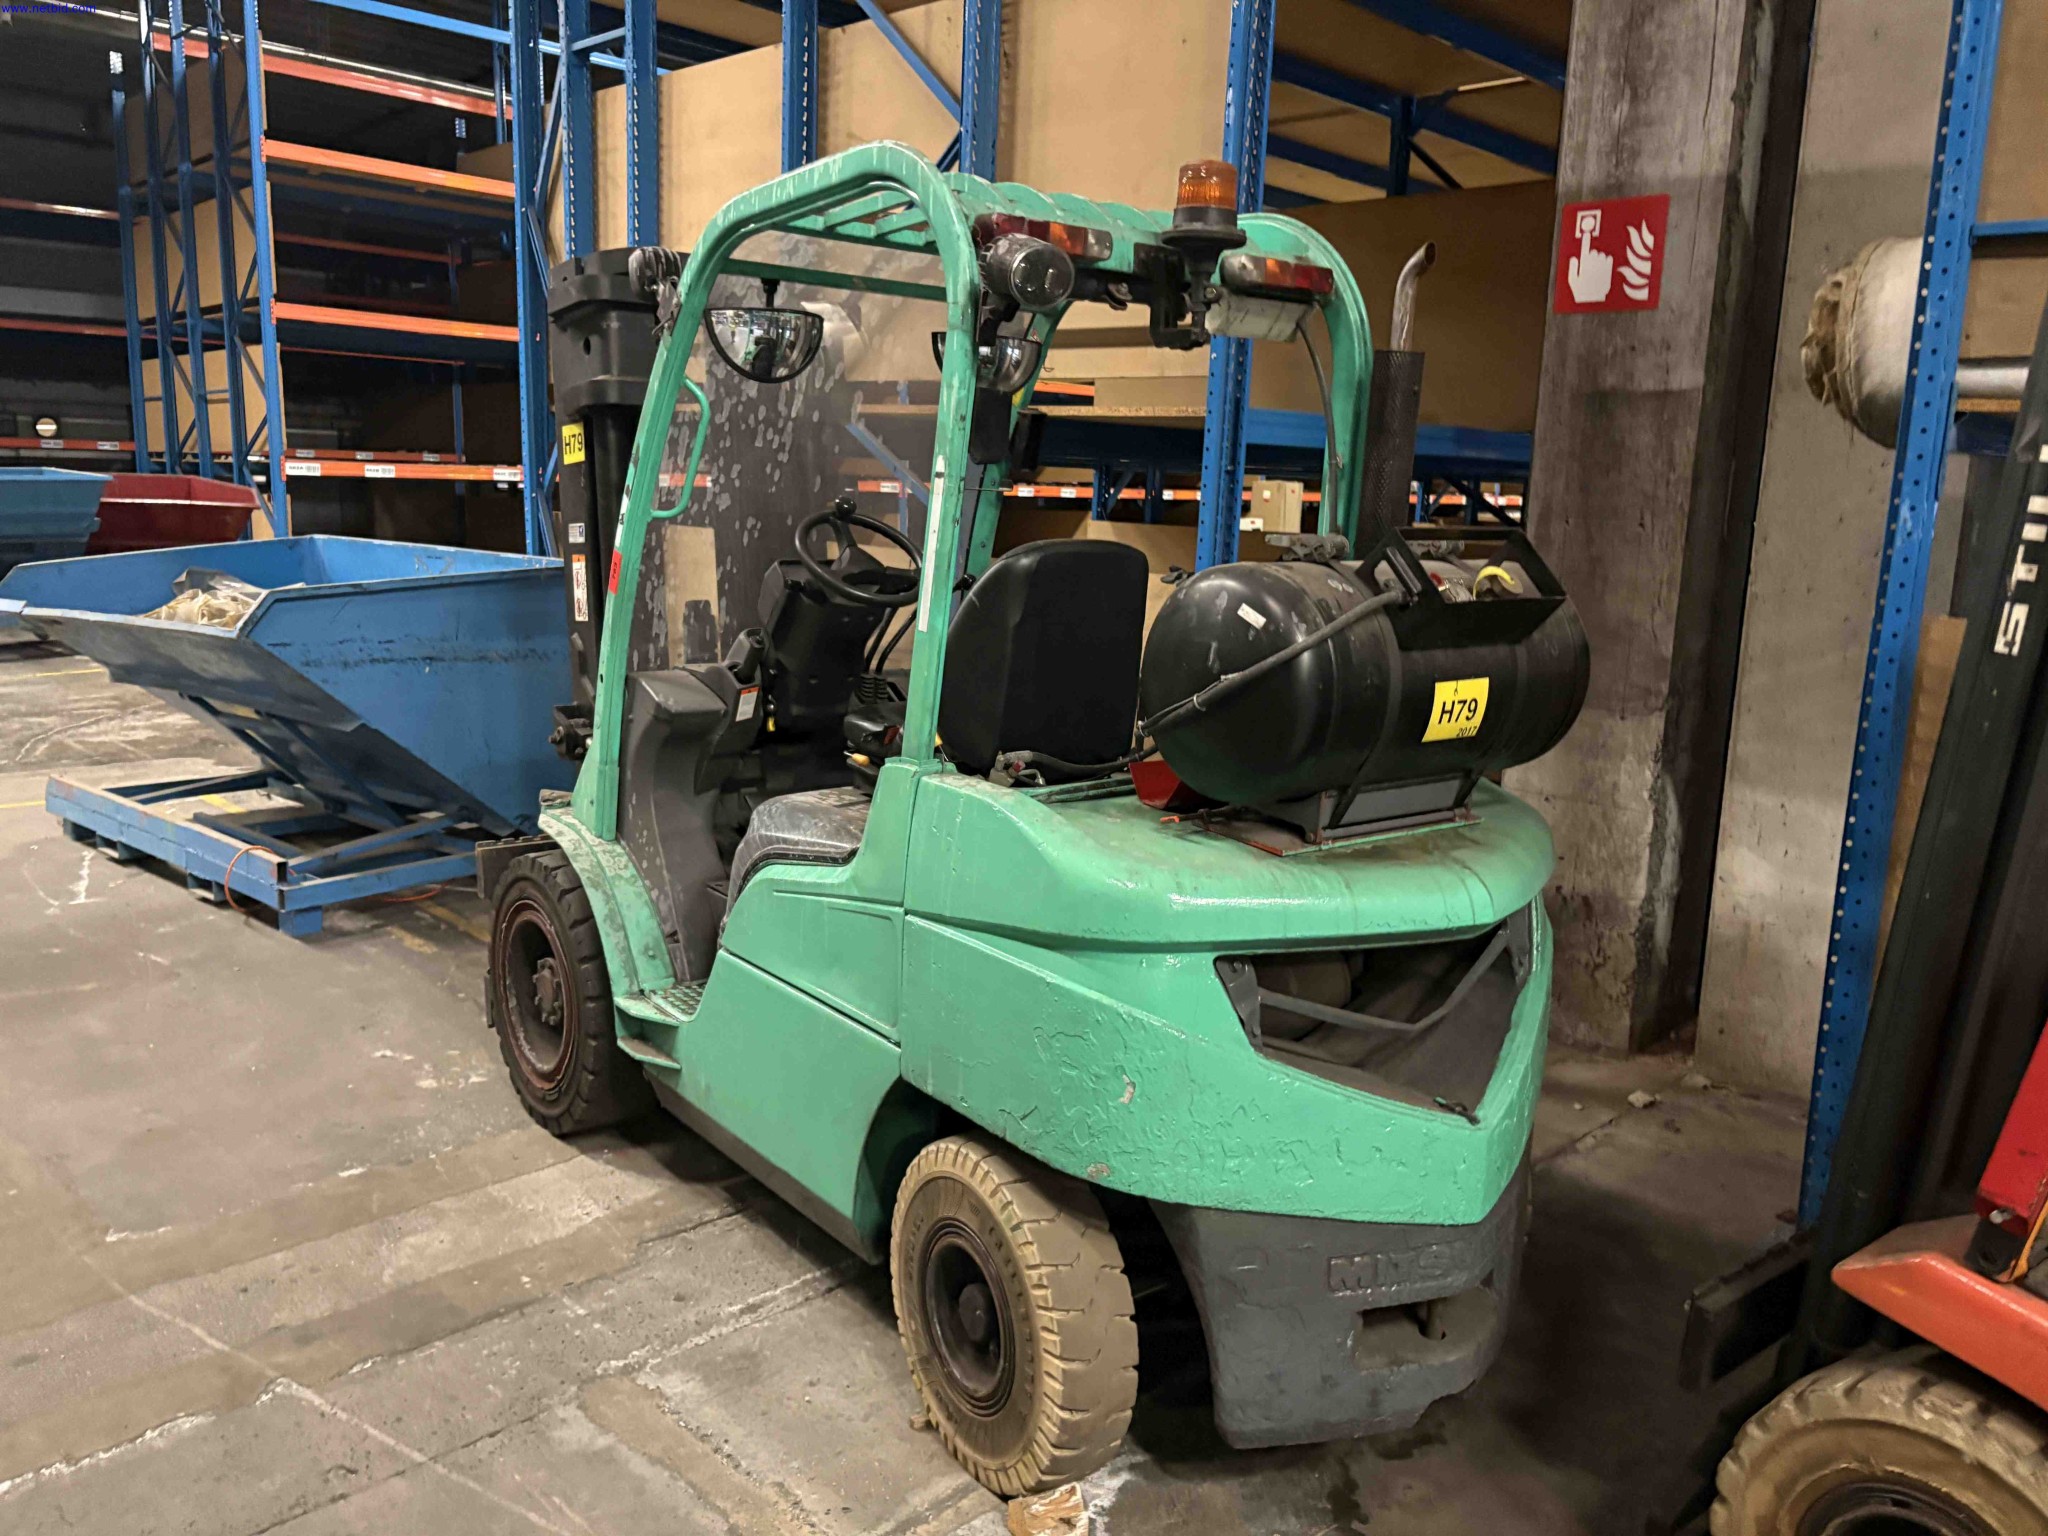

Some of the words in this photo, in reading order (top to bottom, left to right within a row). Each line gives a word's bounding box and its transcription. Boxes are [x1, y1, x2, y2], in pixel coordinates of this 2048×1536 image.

[564, 432, 584, 455] H79
[1438, 697, 1479, 724] H79
[1456, 726, 1477, 737] 2017
